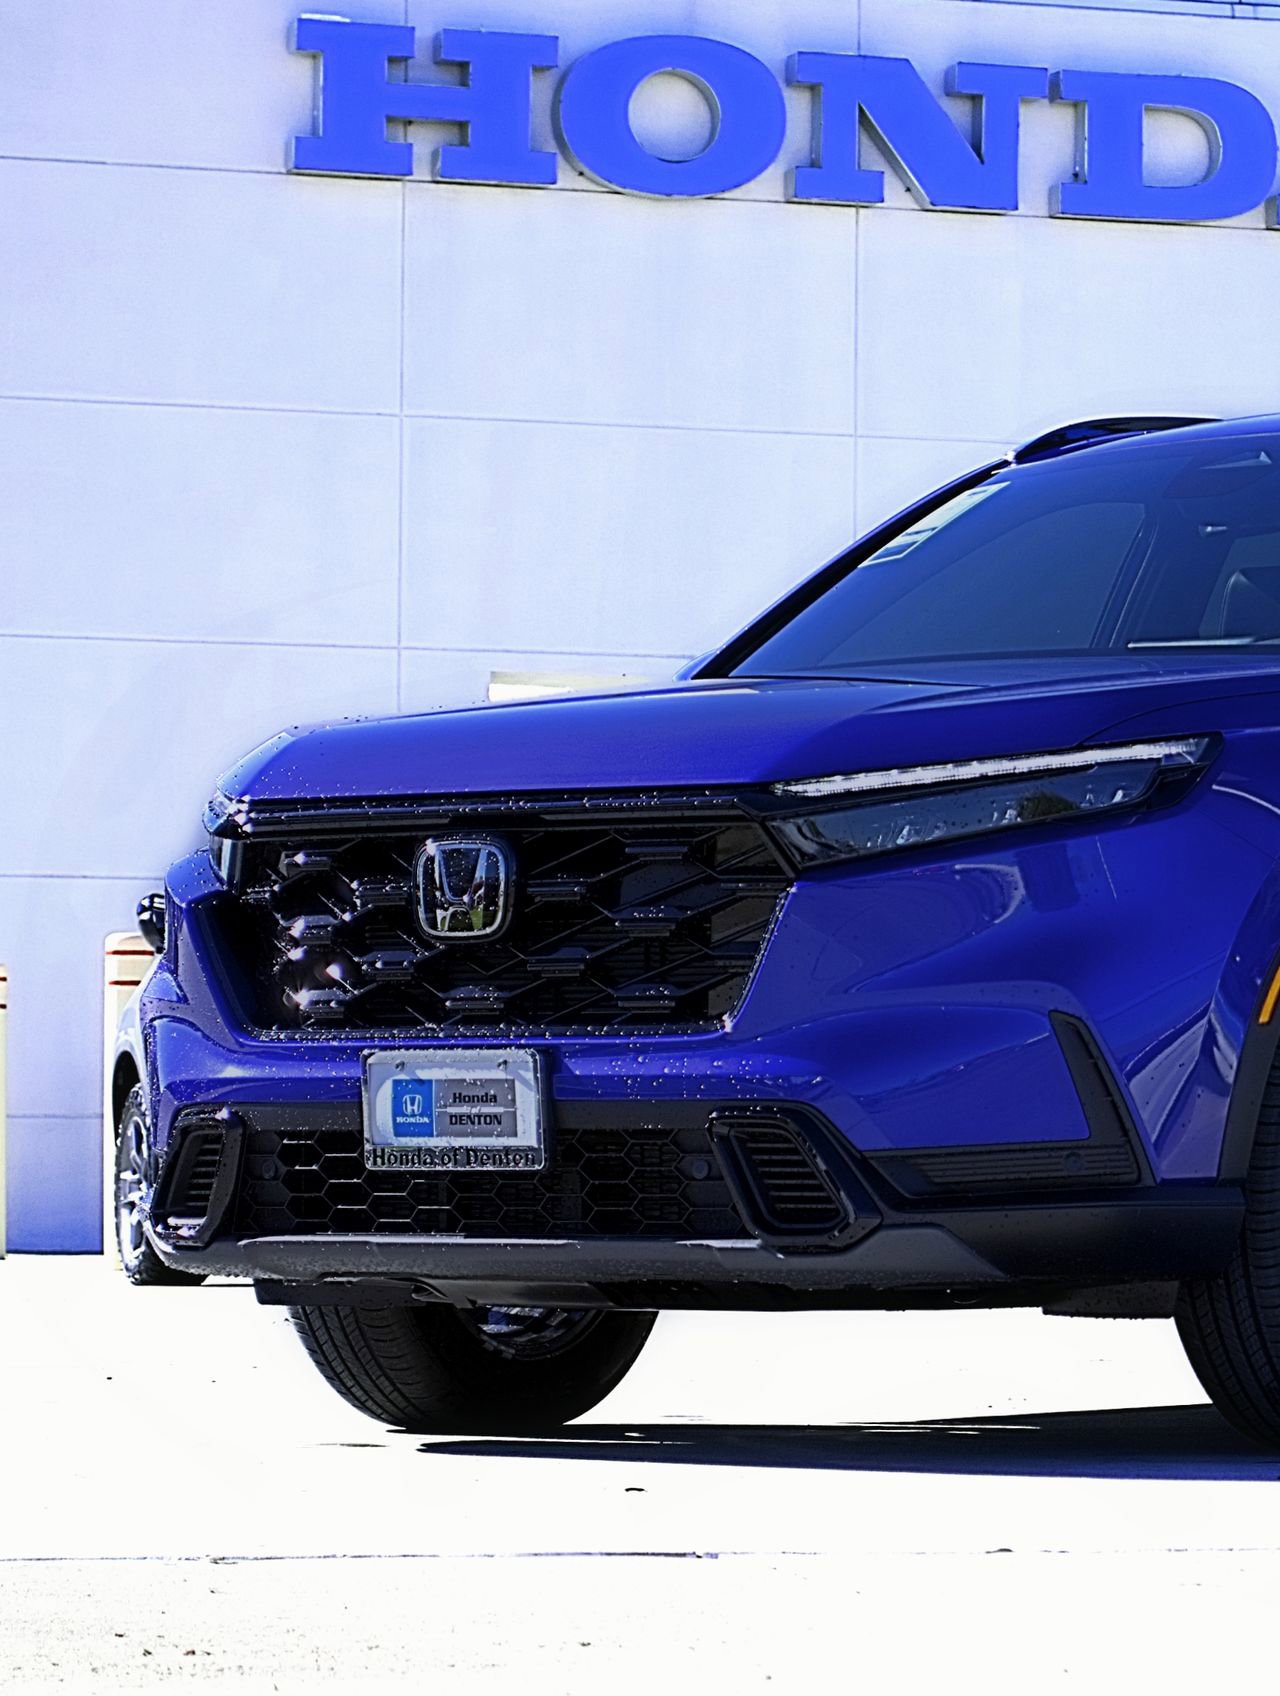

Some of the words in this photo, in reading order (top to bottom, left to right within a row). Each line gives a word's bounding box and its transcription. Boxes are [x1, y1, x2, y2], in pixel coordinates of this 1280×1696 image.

[453, 1092, 497, 1103] Honda
[396, 1116, 430, 1124] HONDA
[449, 1114, 502, 1125] DENTON
[372, 1149, 434, 1167] Honda
[440, 1149, 459, 1167] of
[466, 1148, 536, 1167] Denton
